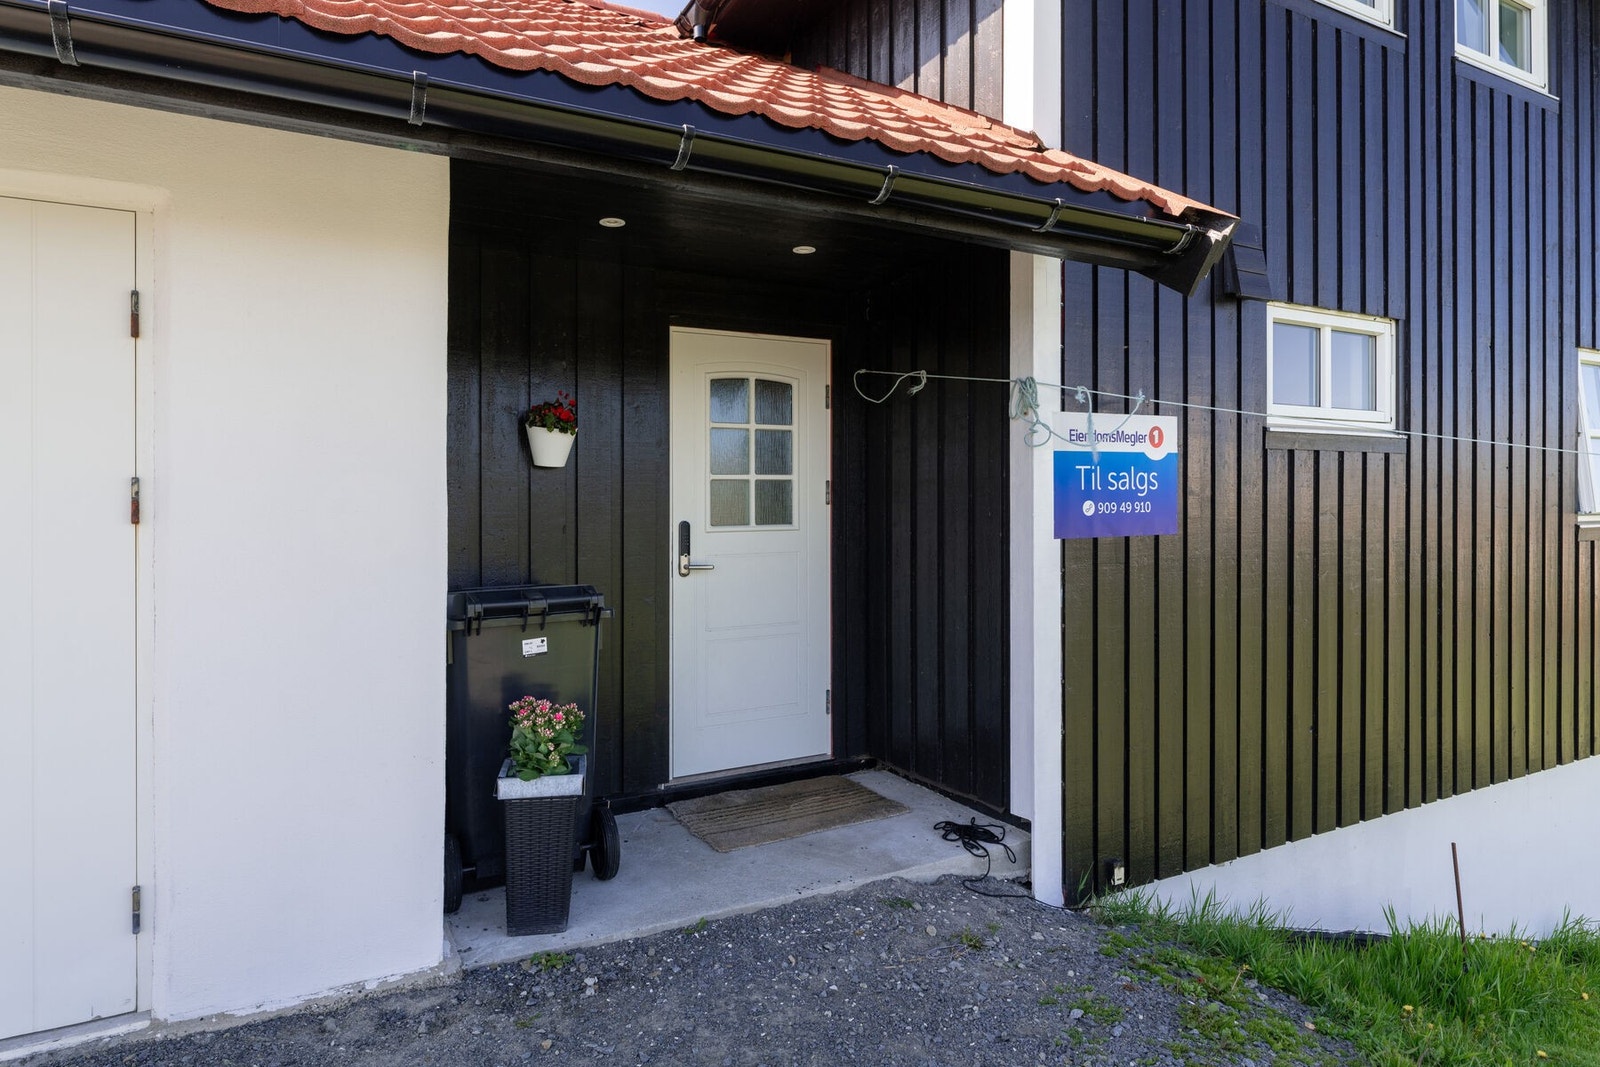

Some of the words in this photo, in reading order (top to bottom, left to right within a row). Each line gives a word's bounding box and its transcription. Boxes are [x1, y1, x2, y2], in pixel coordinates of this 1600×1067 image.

[1075, 465, 1102, 490] Til
[1108, 465, 1158, 497] salgs
[1098, 502, 1117, 514] 909
[1119, 502, 1132, 513] 49
[1134, 501, 1151, 513] 910
